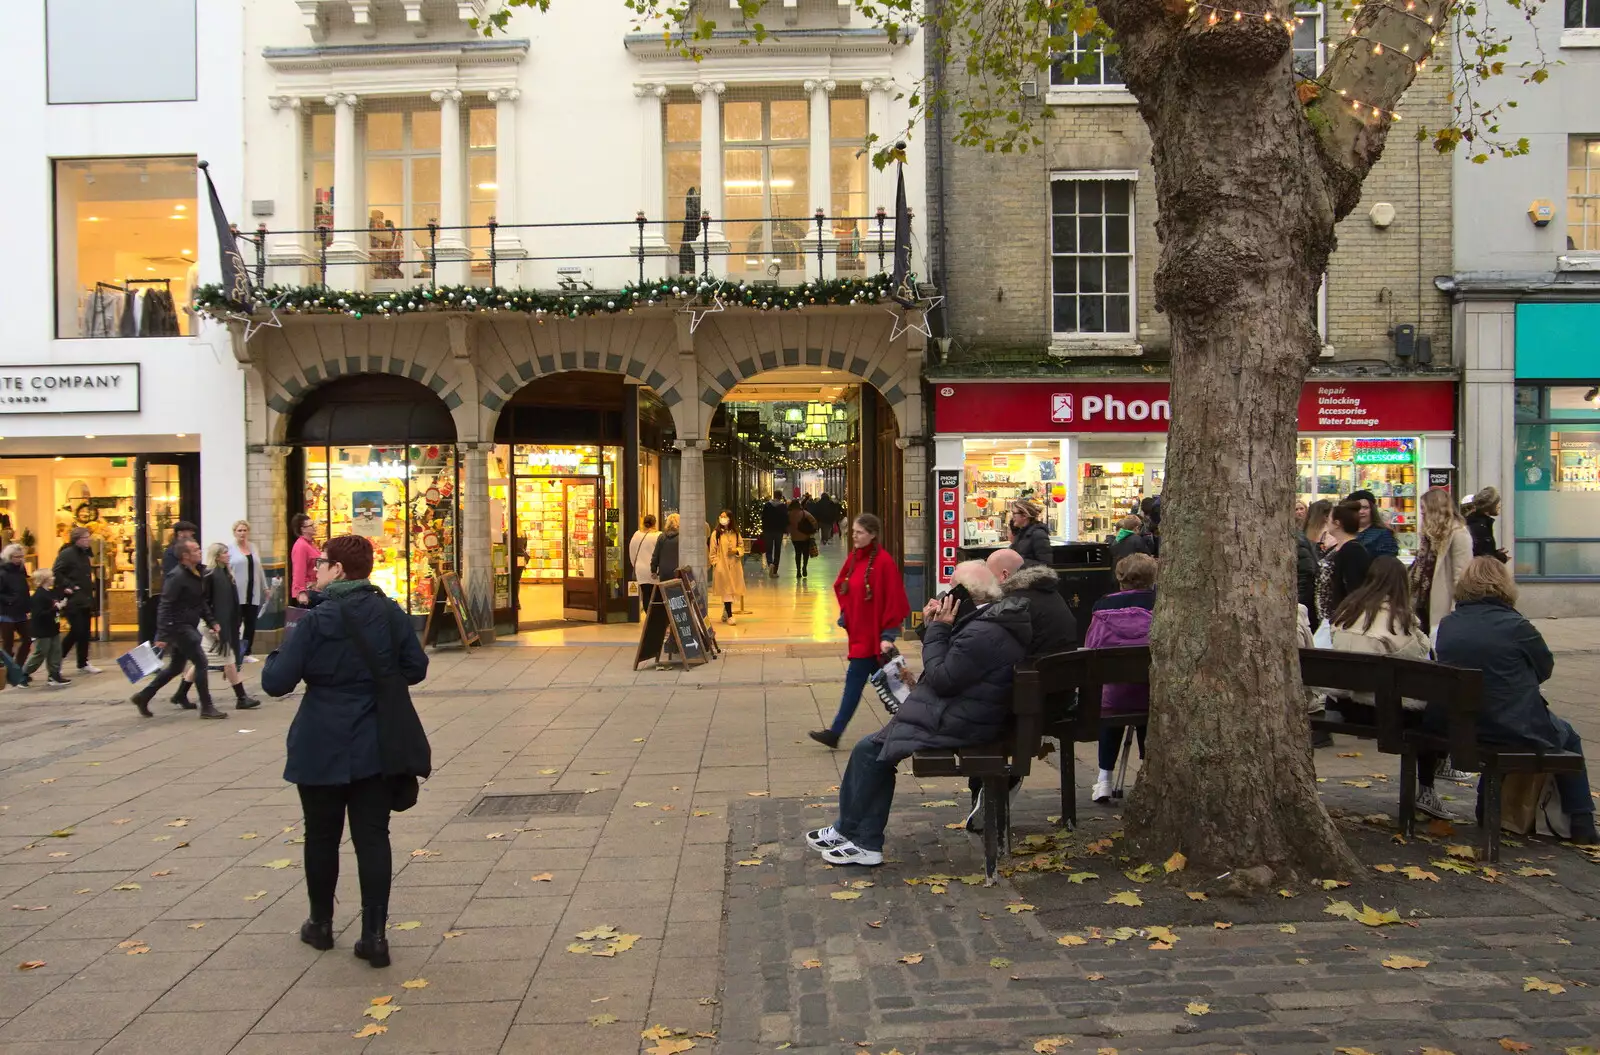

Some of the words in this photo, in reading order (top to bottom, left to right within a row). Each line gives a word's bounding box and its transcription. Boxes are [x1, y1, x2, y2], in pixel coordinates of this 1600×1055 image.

[31, 375, 120, 388] COMPANY
[1318, 387, 1345, 395] Repair
[1318, 397, 1360, 406] Unlocking
[1318, 407, 1367, 415] Accessories
[1318, 417, 1344, 425] Water
[1345, 417, 1379, 426] Damage
[1356, 453, 1411, 461] ACCESSORIES
[909, 502, 921, 517] H
